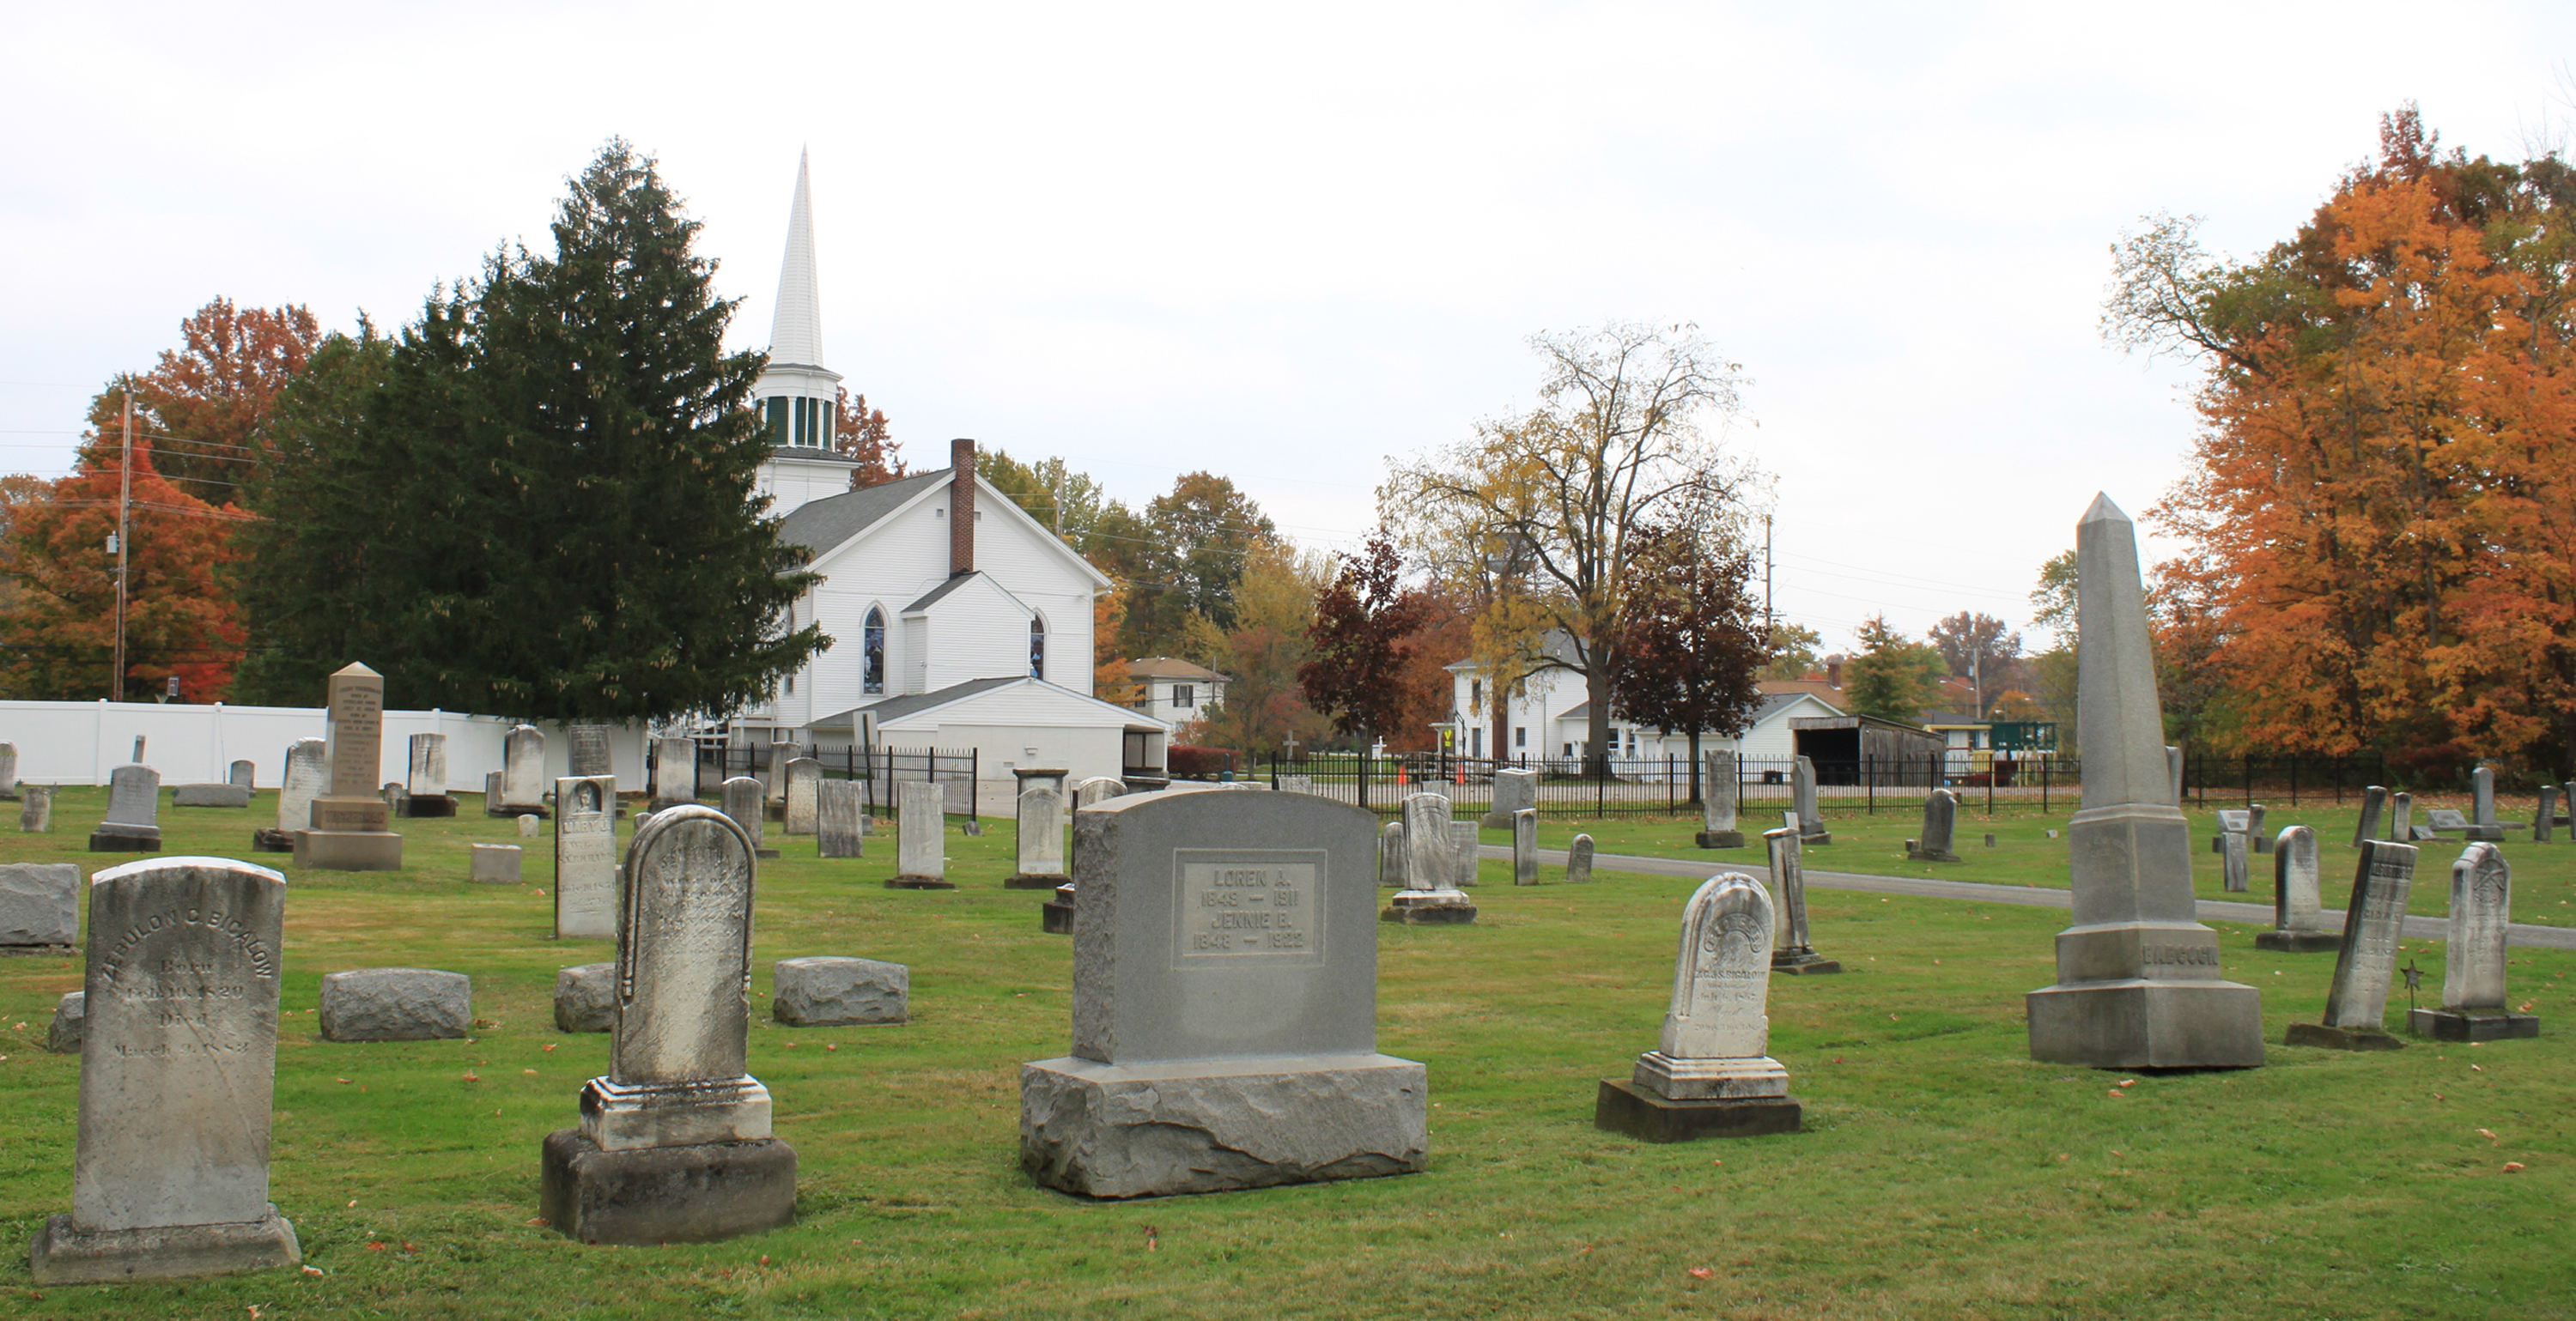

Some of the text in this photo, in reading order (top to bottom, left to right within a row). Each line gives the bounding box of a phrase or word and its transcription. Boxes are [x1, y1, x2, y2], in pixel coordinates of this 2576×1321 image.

[562, 820, 598, 834] MARY
[1214, 868, 1291, 887] LOREN A.
[1273, 888, 1299, 906] 1911
[1211, 910, 1271, 929] JENNIE
[2142, 943, 2219, 966] BABCOCK
